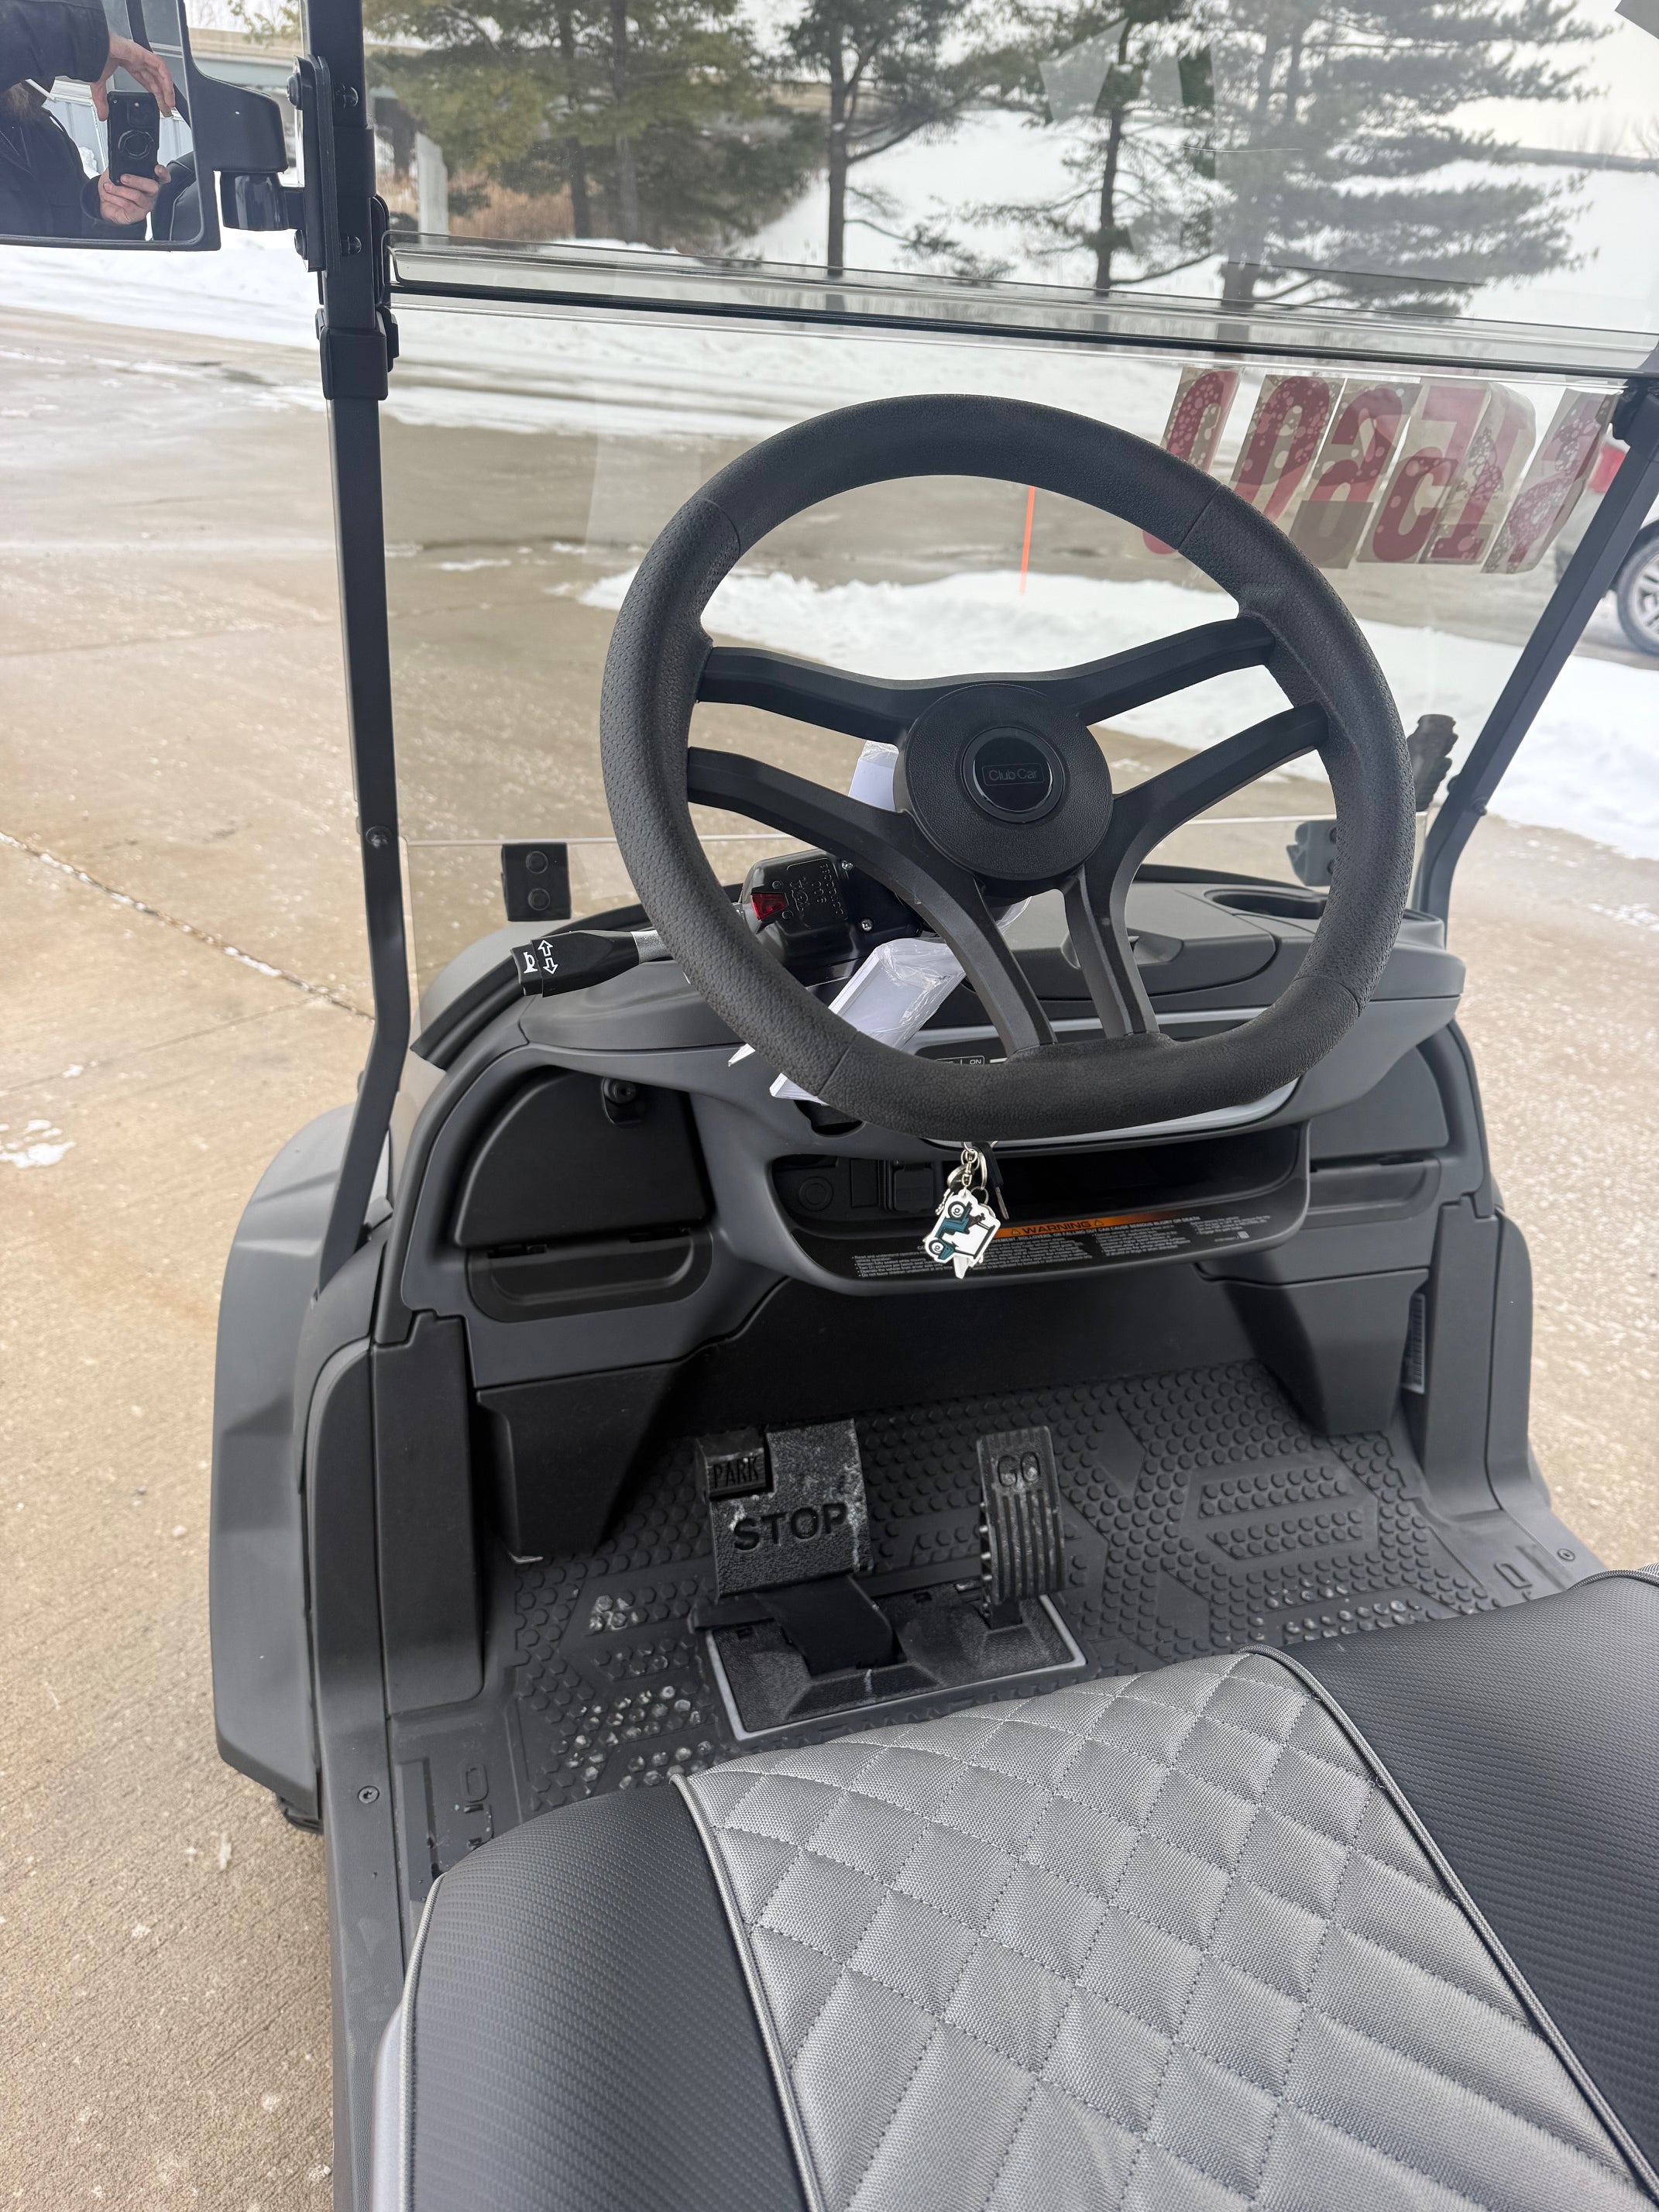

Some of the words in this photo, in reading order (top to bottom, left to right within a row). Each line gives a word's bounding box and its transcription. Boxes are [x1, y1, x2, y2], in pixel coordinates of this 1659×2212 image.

[988, 768, 1016, 781] Club
[1017, 768, 1038, 780] Car
[1022, 1221, 1091, 1234] WARNING
[712, 1456, 761, 1489] PARK
[996, 1451, 1042, 1488] GO
[733, 1503, 849, 1552] STOP
